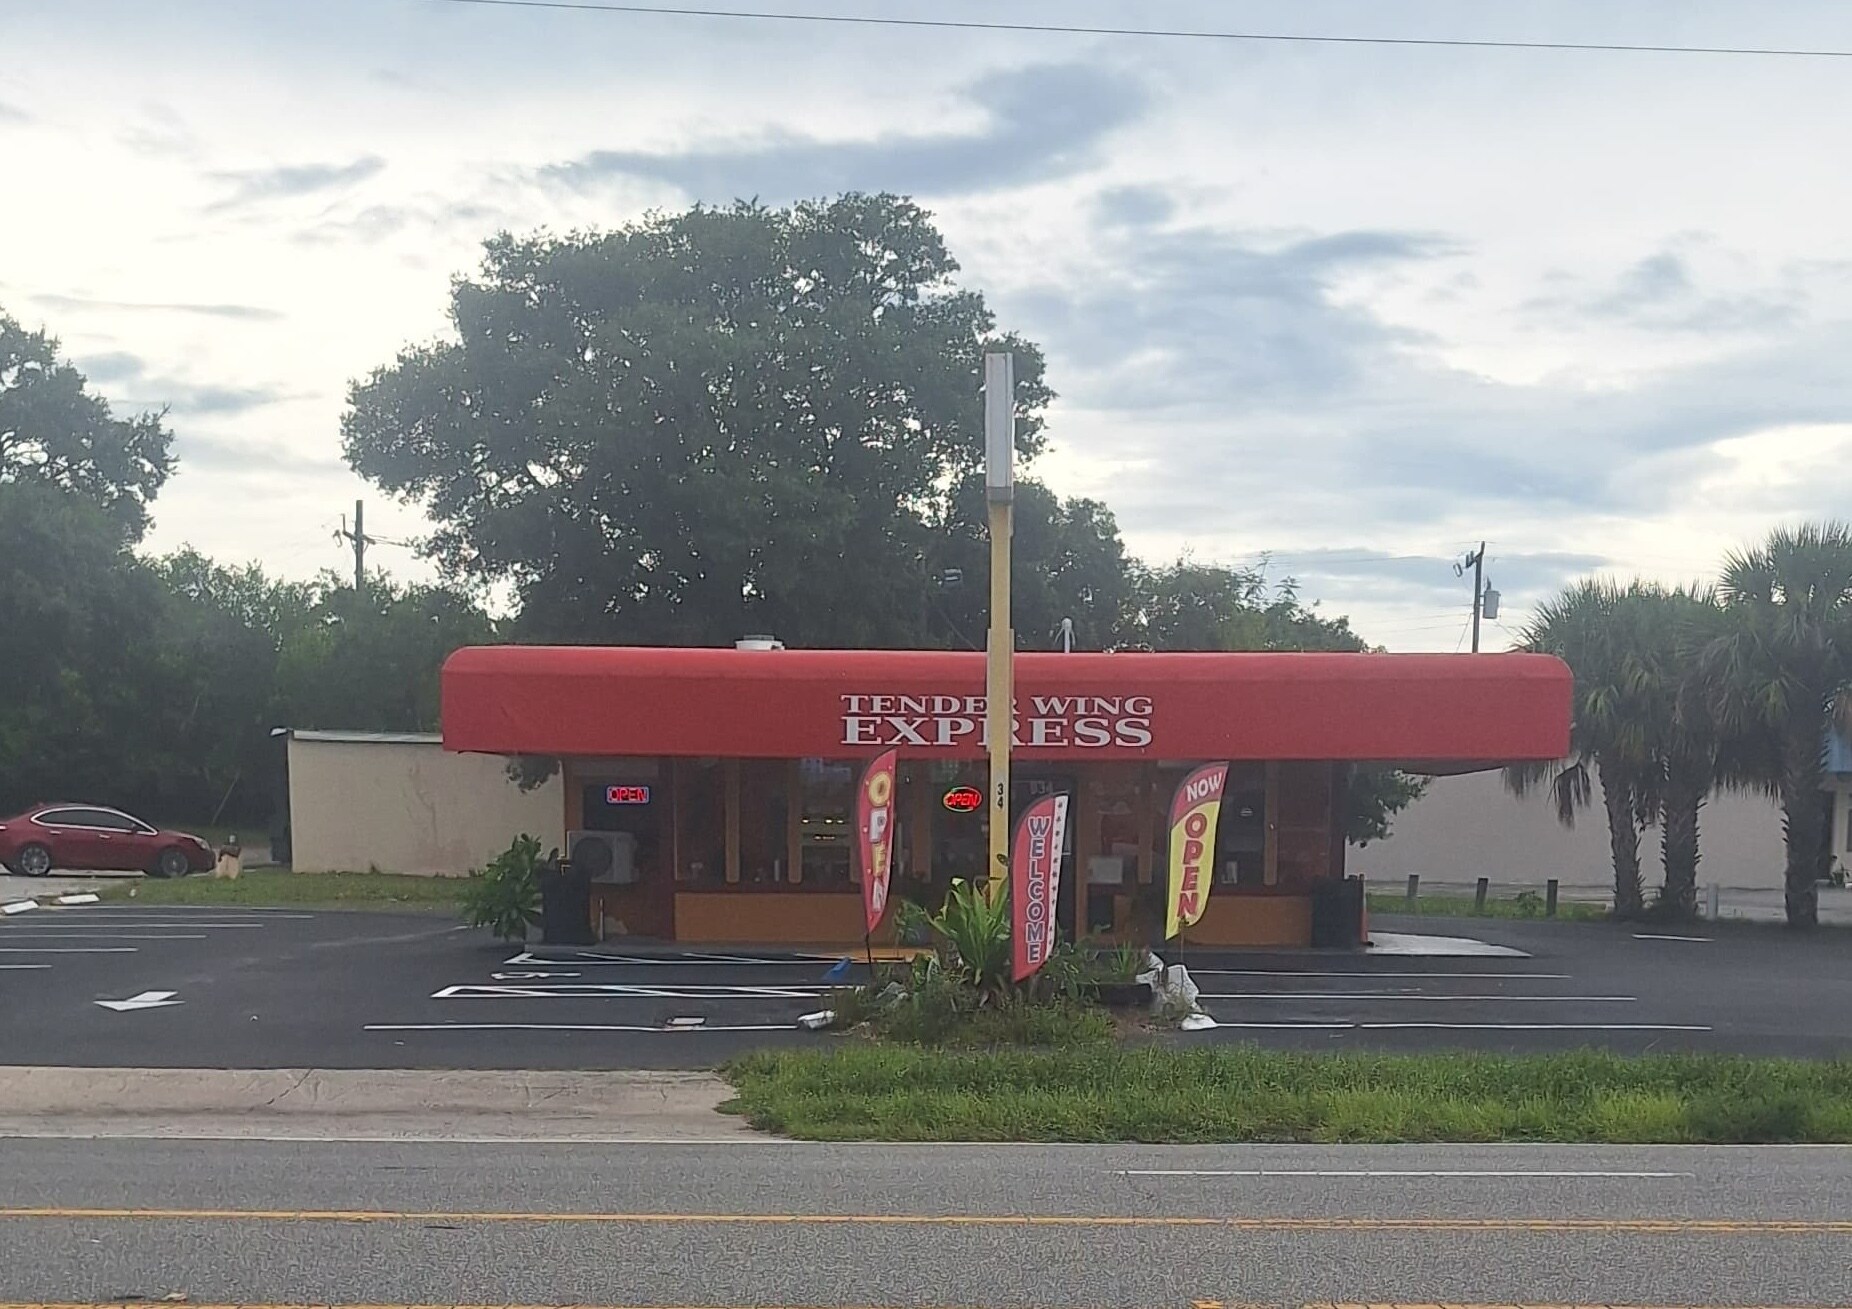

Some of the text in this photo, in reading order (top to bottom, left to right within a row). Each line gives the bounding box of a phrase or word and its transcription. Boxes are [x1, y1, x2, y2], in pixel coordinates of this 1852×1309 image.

[841, 695, 1153, 716] TENDE WING
[609, 788, 647, 802] OPEN
[945, 793, 978, 806] OPEN
[1186, 773, 1222, 802] NOW
[1177, 812, 1208, 917] OPEN
[1026, 816, 1052, 963] WELCOME
